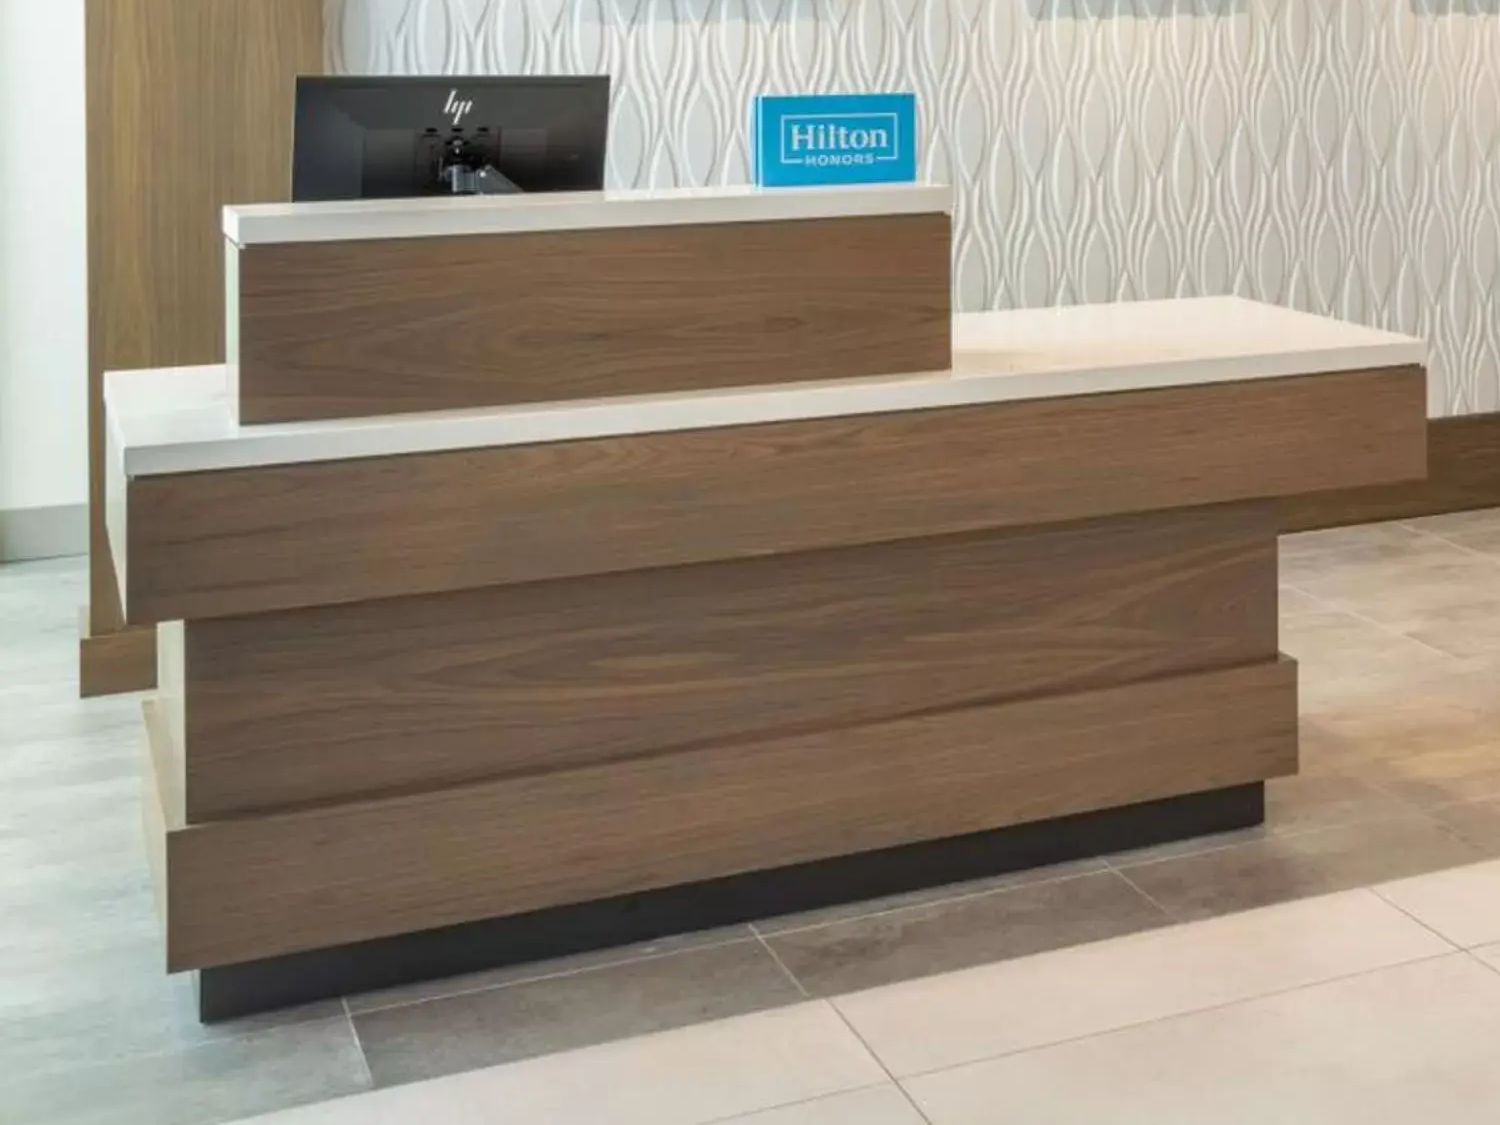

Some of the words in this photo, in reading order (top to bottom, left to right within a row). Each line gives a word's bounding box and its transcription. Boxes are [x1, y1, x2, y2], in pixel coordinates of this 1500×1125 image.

[444, 89, 473, 124] hp
[791, 123, 888, 151] Hilton
[804, 153, 874, 166] HONORS
